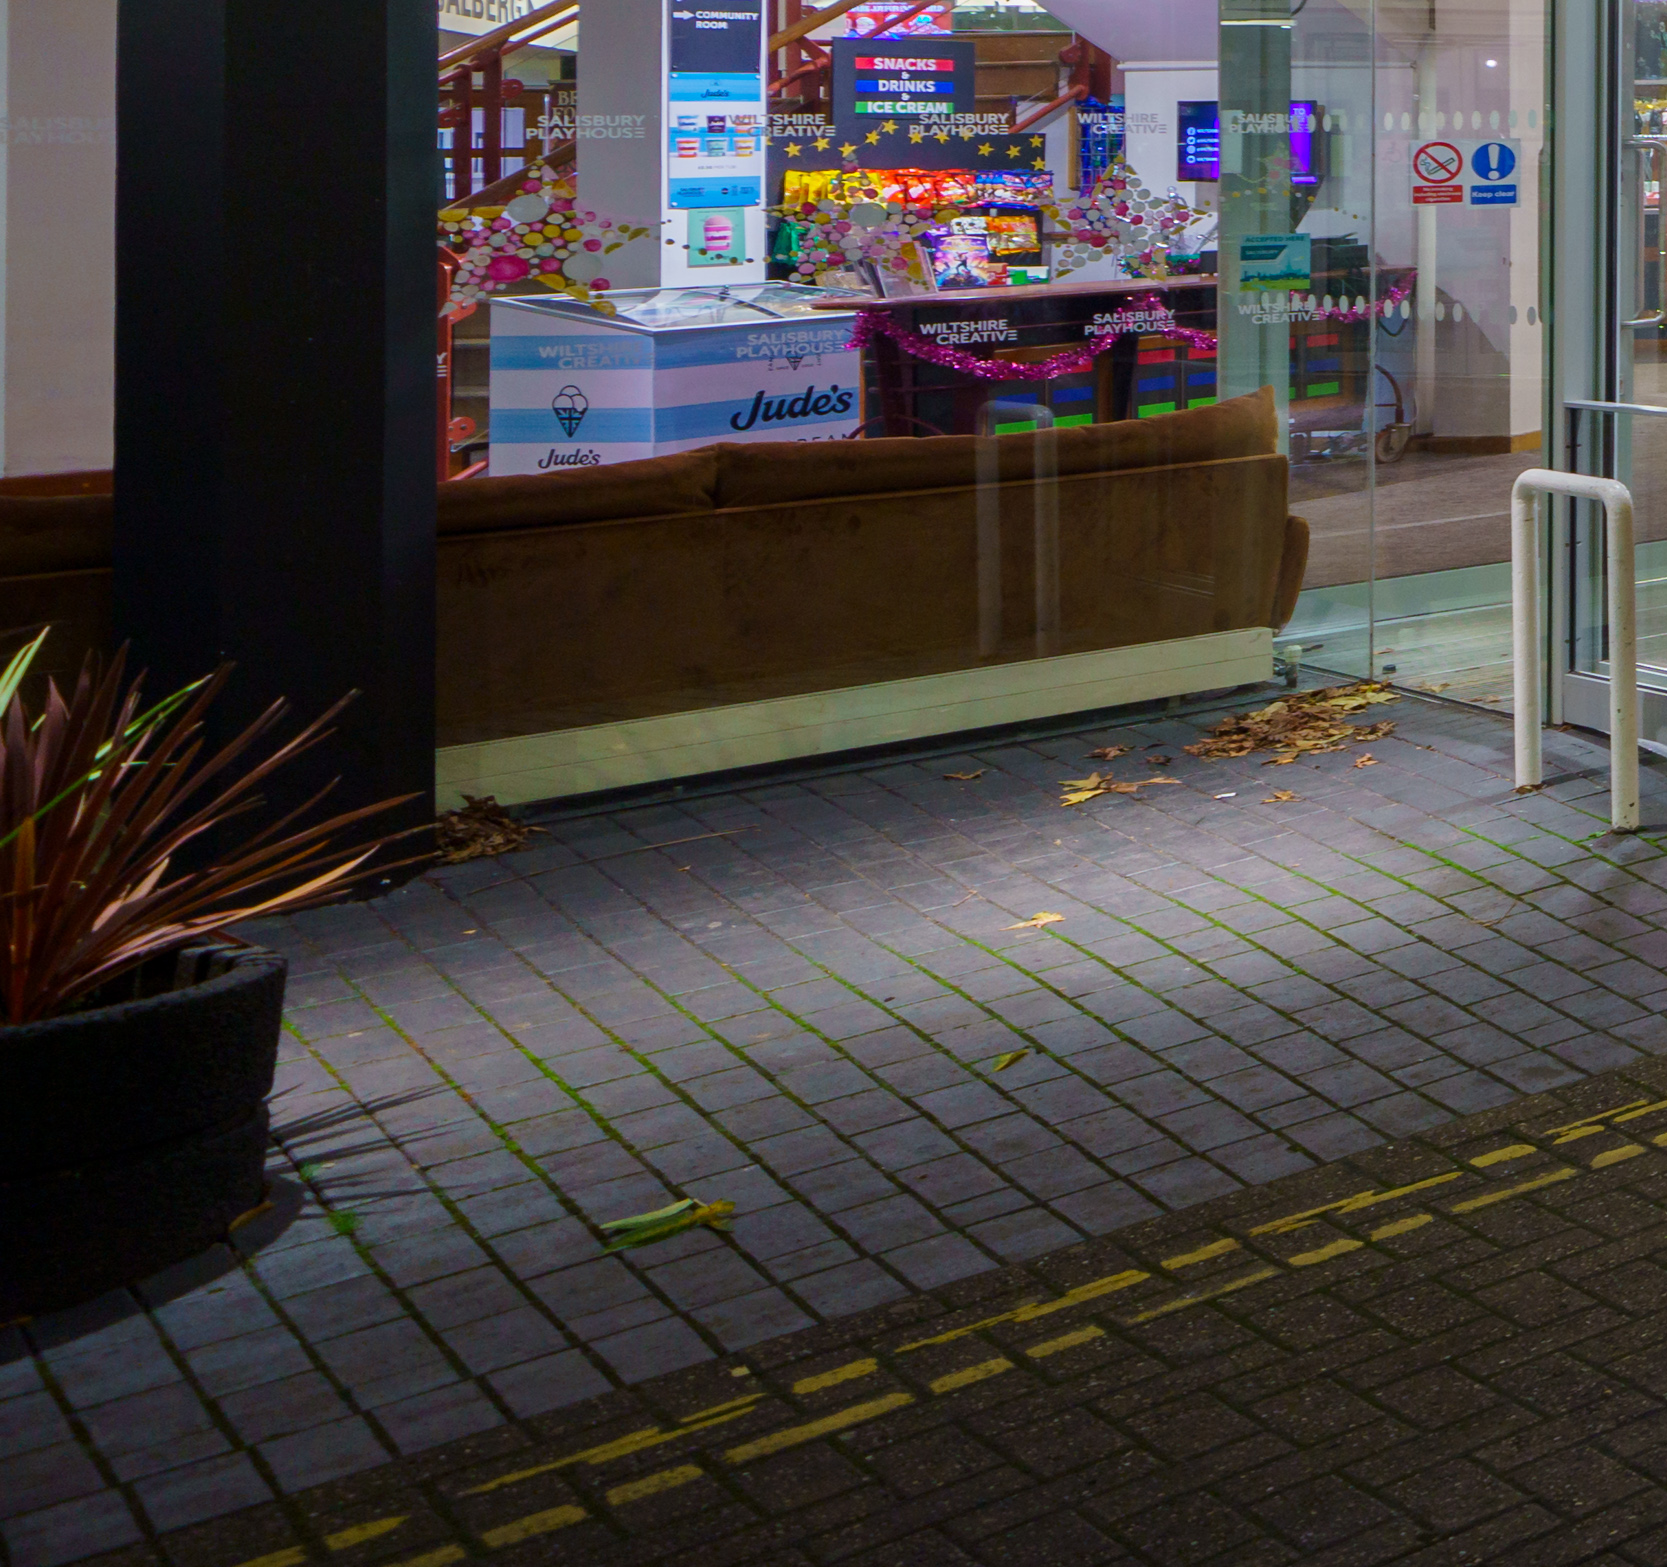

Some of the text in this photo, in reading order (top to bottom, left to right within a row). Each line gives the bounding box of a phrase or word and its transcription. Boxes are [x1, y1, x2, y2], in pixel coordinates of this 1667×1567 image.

[695, 10, 759, 21] COMMUNITY
[695, 21, 728, 30] ROOM
[873, 58, 937, 71] SNACKS
[901, 71, 910, 80] &
[878, 79, 935, 92] DRINKS
[901, 92, 910, 101] &
[867, 101, 948, 114] ICE CREAM
[537, 115, 645, 128] SALISBURY
[728, 113, 826, 125] WILTSHIRE
[918, 113, 1009, 125] SALISBURY
[1077, 113, 1158, 124] WILTSHIRE
[1238, 113, 1309, 124] SALISBU
[526, 127, 645, 140] PLAYHOUSE
[746, 124, 836, 137] CREATIVE
[908, 124, 1009, 136] PLAYHOUSE
[1092, 123, 1167, 134] CREATIVE
[1472, 191, 1493, 199] Keep
[1238, 302, 1311, 315] WILTSHRE
[1092, 309, 1176, 324] SALISBURY
[920, 319, 1009, 335] WILTSHIRE
[1084, 319, 1176, 336] PLAYHOUSE
[747, 329, 846, 346] SALISBURY
[936, 329, 1018, 345] CREATIVE
[538, 340, 644, 359] WILTSHIRE
[736, 340, 847, 359] PLAYHOUSE
[730, 385, 853, 431] Jude's
[538, 449, 601, 470] Jude's
